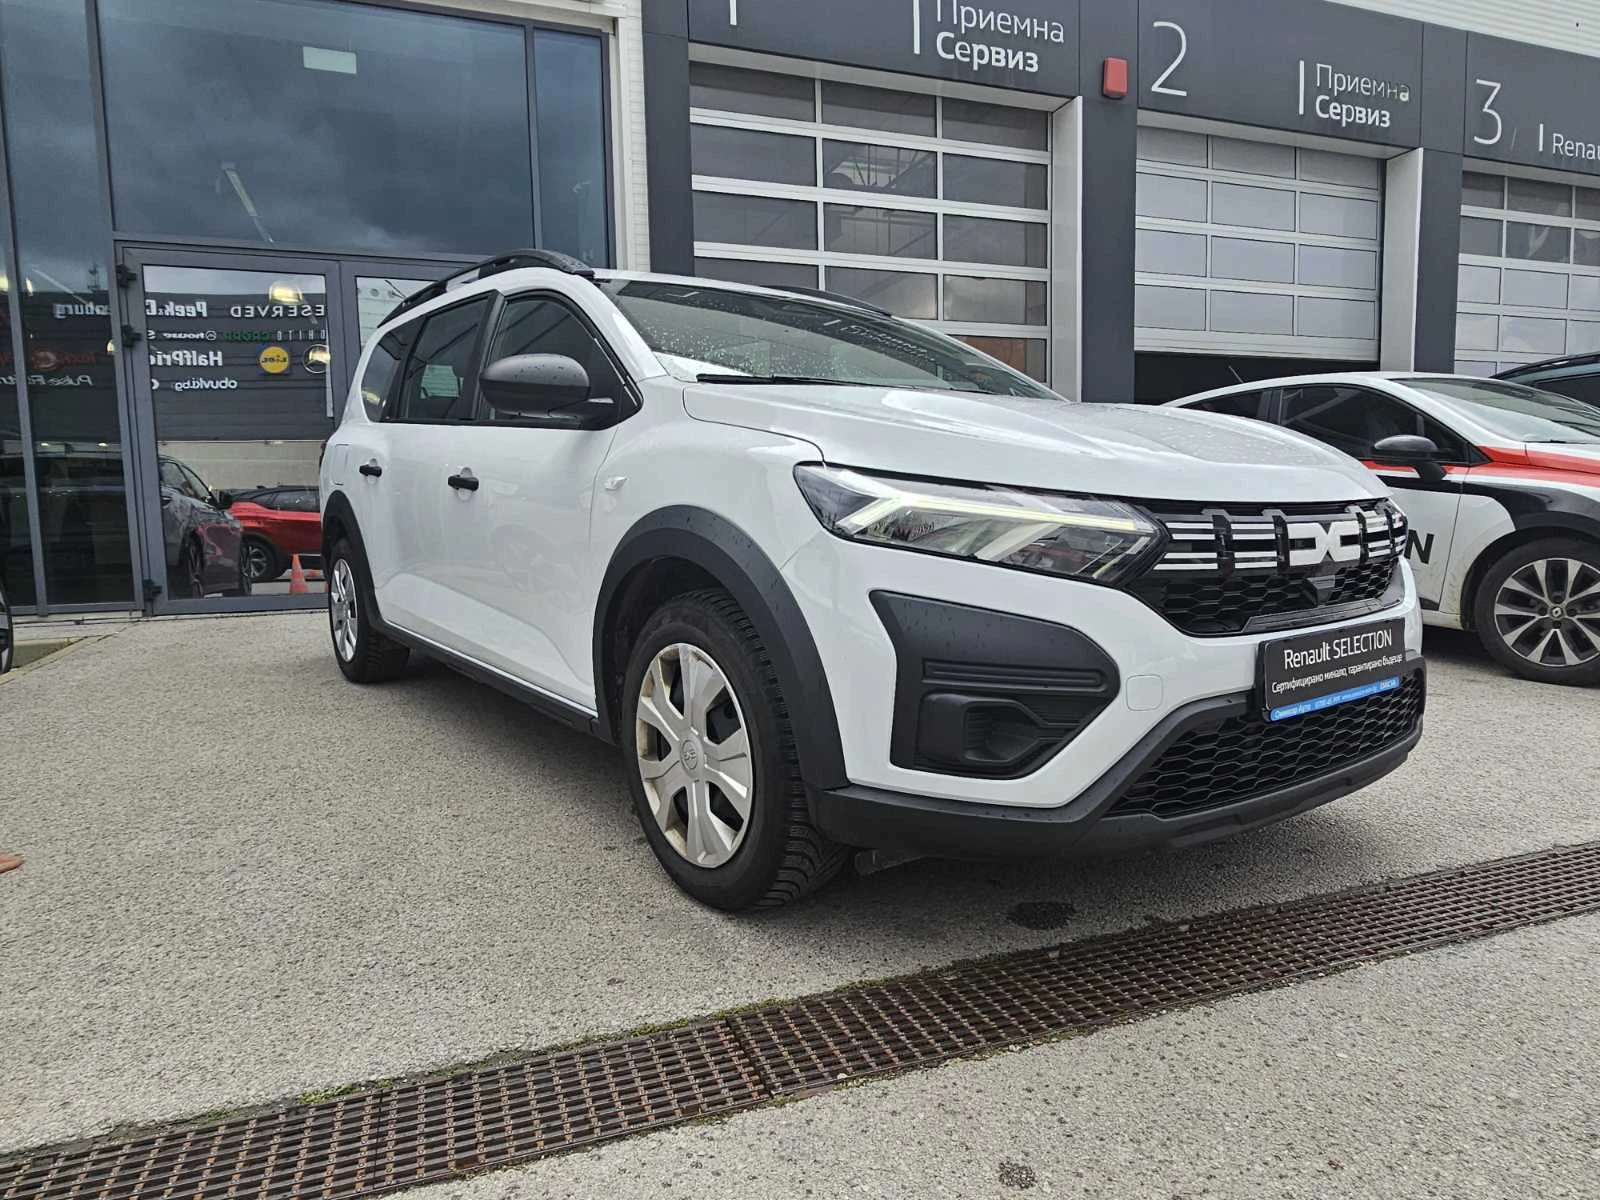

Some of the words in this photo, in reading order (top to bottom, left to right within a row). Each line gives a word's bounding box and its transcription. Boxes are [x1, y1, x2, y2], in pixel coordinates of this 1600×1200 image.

[937, 0, 1064, 43] Приемна
[936, 31, 1039, 73] Сервиз
[1150, 20, 1187, 97] 2
[1316, 63, 1410, 102] Приемна
[1315, 94, 1391, 128] Сервиз
[1472, 78, 1502, 145] 3
[1552, 132, 1600, 160] Rena
[1284, 641, 1331, 669] Renault
[1333, 629, 1393, 659] SELECTION
[1271, 673, 1324, 694] Сертифицирано
